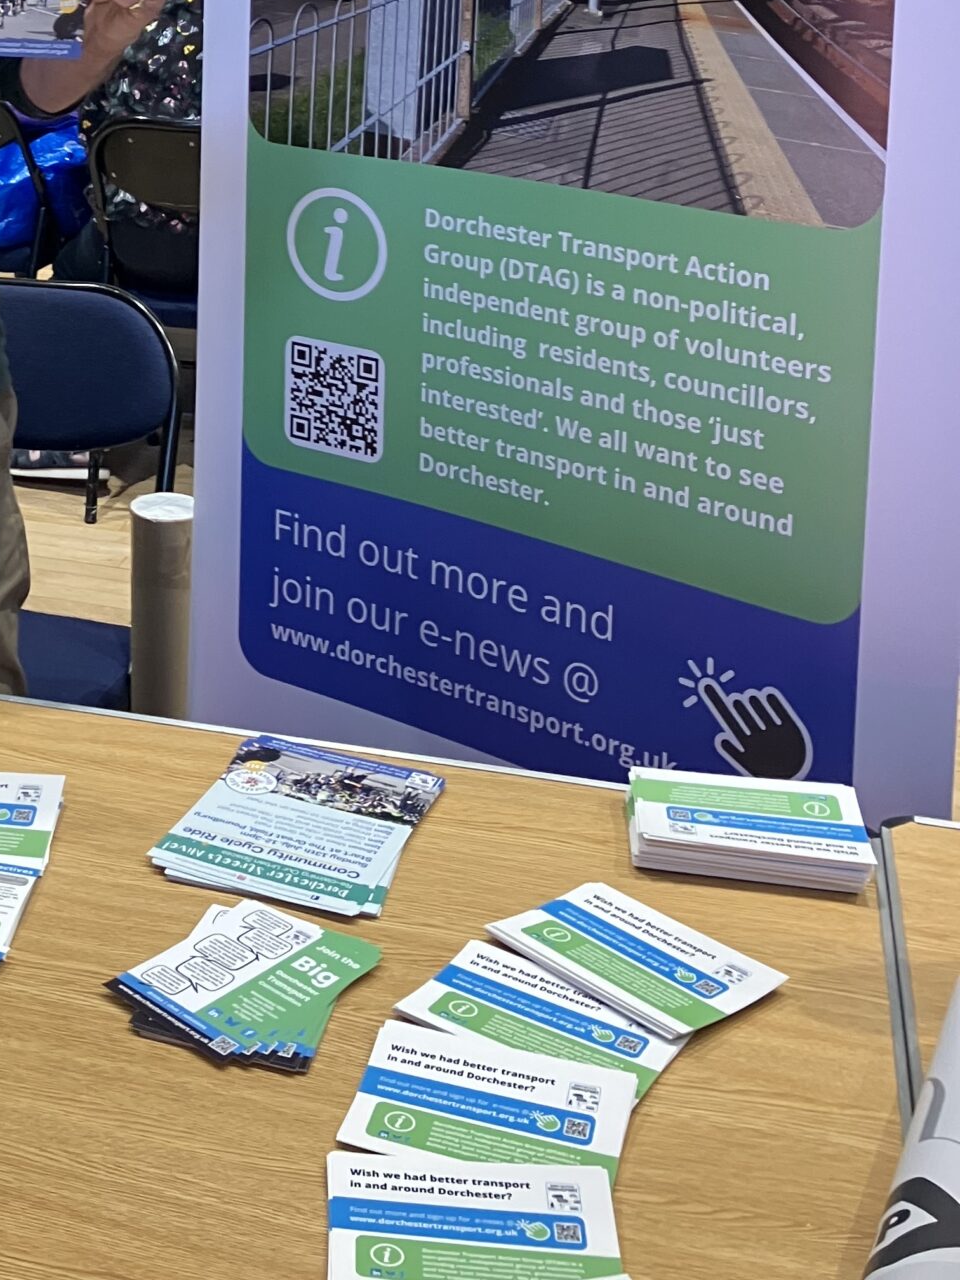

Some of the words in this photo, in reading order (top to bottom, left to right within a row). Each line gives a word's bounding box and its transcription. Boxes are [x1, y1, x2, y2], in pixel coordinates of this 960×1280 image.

[424, 207, 552, 248] Dorchester
[557, 230, 679, 274] Transport
[684, 255, 770, 291] Action
[423, 278, 569, 327] independent
[574, 313, 646, 348] group
[652, 328, 680, 350] of
[684, 336, 832, 383] volunteers
[424, 243, 494, 279] Group
[499, 257, 579, 295] (DTAG)
[586, 272, 605, 296] is
[610, 283, 625, 301] a
[632, 287, 804, 341] non-political,
[421, 352, 574, 401] professionals
[579, 389, 625, 414] and
[631, 398, 701, 434] those
[422, 312, 527, 359] including
[538, 342, 656, 388] residents,
[663, 371, 816, 424] councillors,
[418, 452, 549, 506] Dorchester.
[420, 416, 490, 452] better
[495, 438, 607, 485] transport
[613, 472, 636, 493] in
[642, 481, 690, 508] and
[696, 496, 793, 537] around
[554, 415, 592, 444] We
[598, 428, 627, 453] all
[633, 440, 698, 472] want
[704, 456, 731, 480] to
[738, 468, 784, 494] see
[274, 508, 346, 558] Find
[358, 540, 419, 579] out
[430, 559, 528, 613] more
[540, 594, 613, 641] and
[268, 567, 334, 615] join
[346, 597, 408, 635] our
[419, 619, 550, 685] e-news
[563, 661, 598, 703] @
[272, 623, 678, 771] www.dorchestertransport.org.uk
[290, 956, 340, 988] Big
[386, 1053, 398, 1062] in
[399, 1058, 422, 1067] and
[423, 1063, 464, 1077] around
[466, 1071, 536, 1092] Dorchester?
[390, 1043, 417, 1056] Wish
[420, 1051, 436, 1060] we
[438, 1054, 460, 1065] had
[462, 1059, 498, 1073] better
[500, 1068, 555, 1086] transport
[349, 1167, 379, 1178] Wish
[382, 1172, 400, 1180] we
[403, 1172, 426, 1181] had
[429, 1174, 468, 1185] better
[471, 1178, 530, 1190] transport
[349, 1180, 361, 1188] in
[364, 1182, 387, 1190] and
[390, 1184, 434, 1194] around
[437, 1187, 512, 1200] Dorchester?
